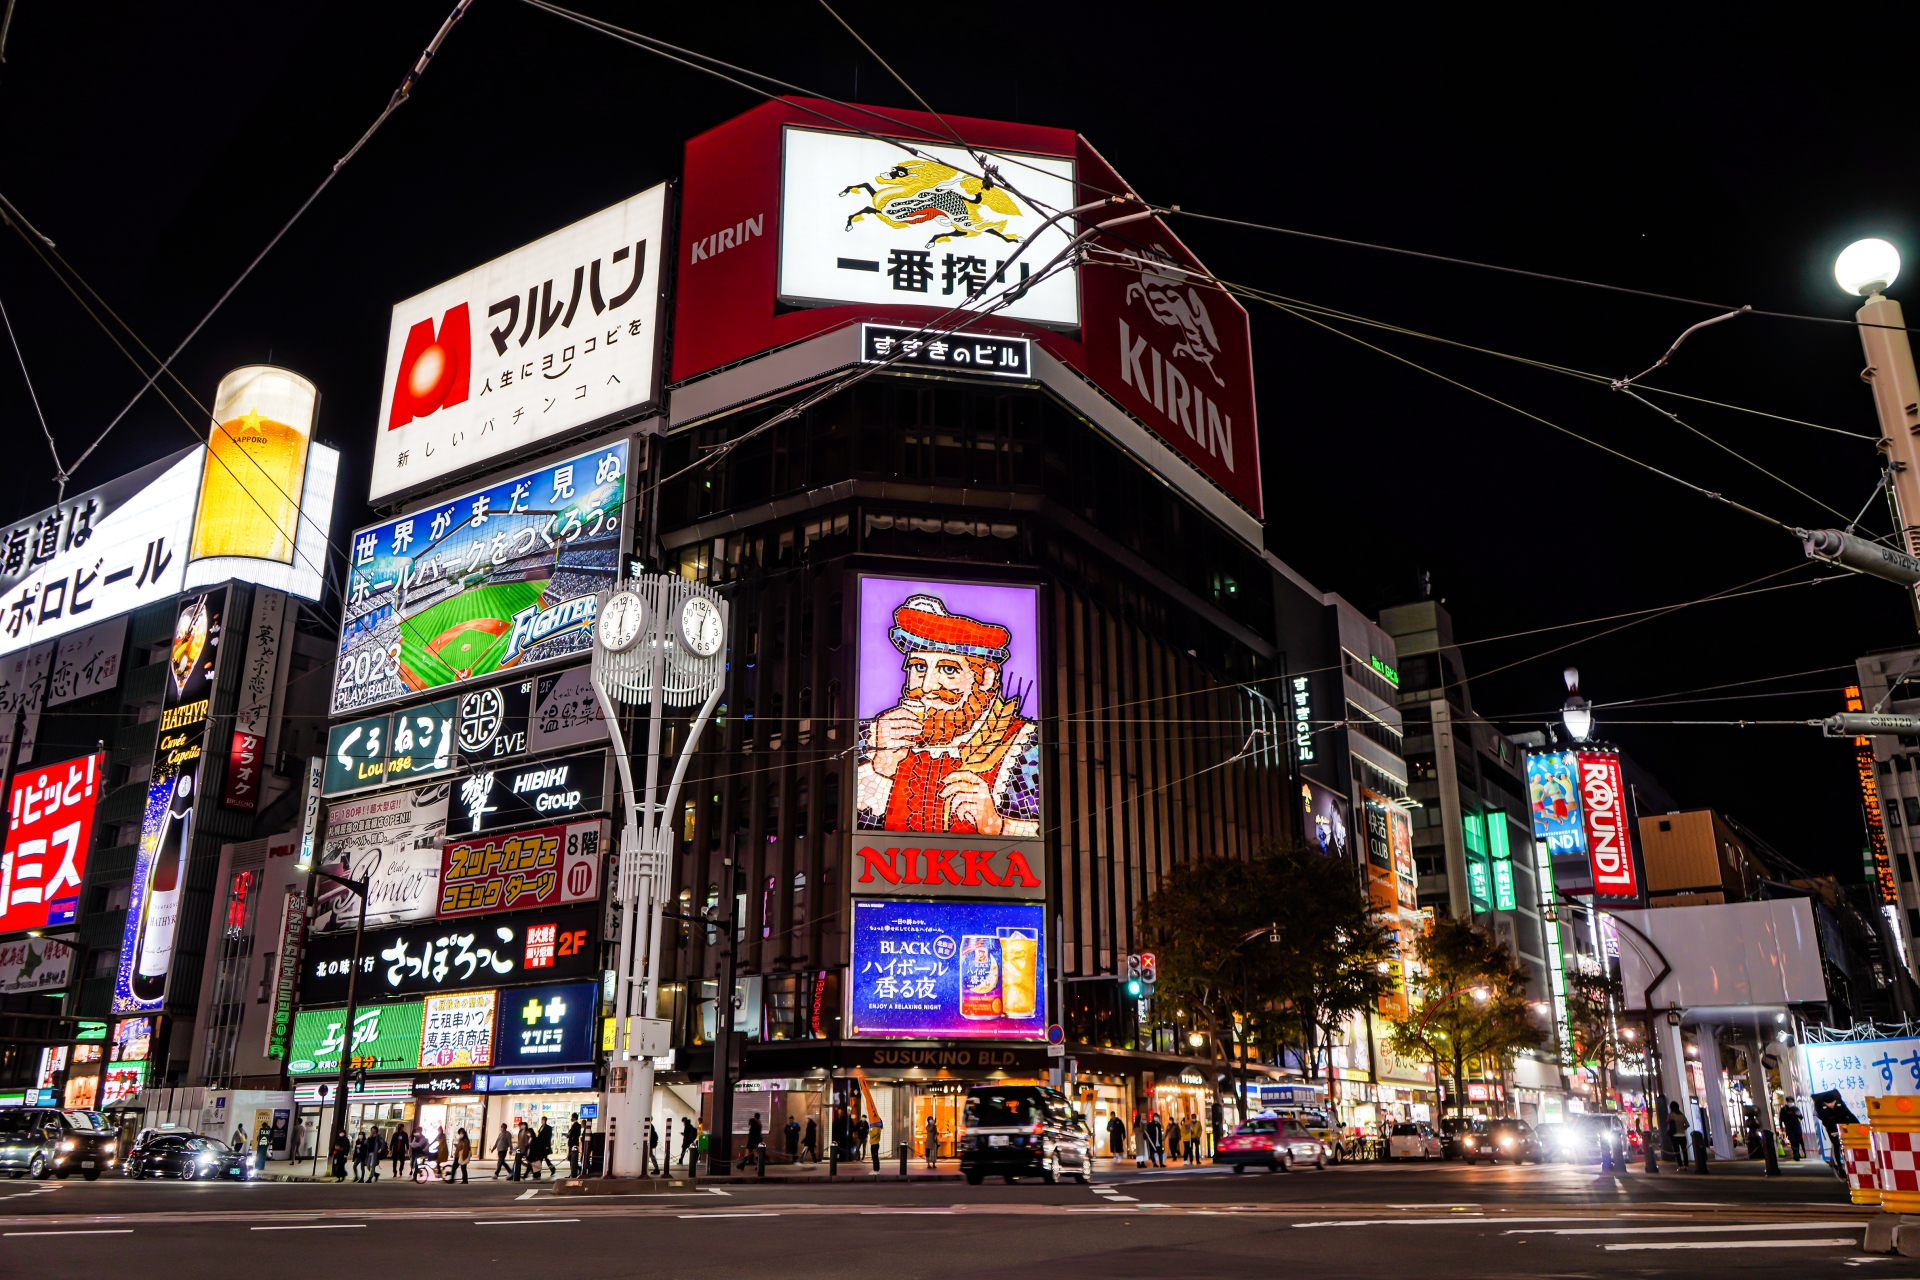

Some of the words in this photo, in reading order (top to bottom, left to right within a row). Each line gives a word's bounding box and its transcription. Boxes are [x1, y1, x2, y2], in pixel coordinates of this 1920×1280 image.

[690, 213, 763, 265] KIRIN
[836, 248, 1031, 301] 一番搾り
[487, 238, 646, 357] マルハン
[480, 318, 642, 396] 人生にヨロコビを
[873, 335, 1020, 368] すすきのビル
[1117, 316, 1234, 474] KIRIN
[396, 374, 621, 469] 新しいパチンコへ
[232, 436, 267, 445] SAPPORO
[356, 452, 621, 567] 世界がまだ見ぬ
[350, 499, 617, 606] ボールパークをつくろう。
[0, 536, 173, 638] ポロビール
[501, 591, 598, 666] FIGHTER
[338, 643, 401, 689] 2023
[336, 688, 368, 704] PLAY
[369, 682, 396, 698] BALL
[521, 681, 532, 694] 8F
[539, 680, 552, 694] 2F
[539, 696, 595, 734] 温野菜
[337, 715, 435, 771] くろねこ
[493, 731, 526, 757] EVE
[234, 736, 258, 795] カラオケ
[358, 755, 412, 780] Lounge
[512, 766, 569, 794] HIBIKI
[312, 778, 319, 788] 2
[461, 771, 498, 833] 響
[536, 790, 581, 812] Group
[1368, 810, 1387, 839] 快活
[1583, 763, 1631, 884] ROUND1
[1609, 765, 1618, 797] SPORTS
[1614, 800, 1628, 870] ENTERTAINMENT
[446, 835, 558, 879] ネットカフェ
[566, 829, 599, 856] 8階
[1370, 838, 1389, 859] CLUB
[856, 846, 1042, 888] NIKKA
[440, 878, 502, 912] コミック
[506, 870, 558, 903] ダーツ
[289, 895, 307, 911] 24H
[527, 926, 556, 945] 炭火焼き
[557, 930, 587, 957] 2F
[880, 941, 931, 955] BLACK
[381, 927, 514, 986] さっぽろっこ
[861, 957, 949, 977] ハイボール
[873, 976, 938, 999] 香る夜
[428, 1011, 485, 1029] 元祖串かつ
[425, 1029, 490, 1048] 恵美須商店
[521, 1028, 564, 1045] サツドラ
[873, 1050, 971, 1066] SUSUKINO
[978, 1051, 1020, 1066] BLD.
[1817, 1055, 1867, 1072] ずっと好き。
[1821, 1076, 1870, 1090] もっと好き。
